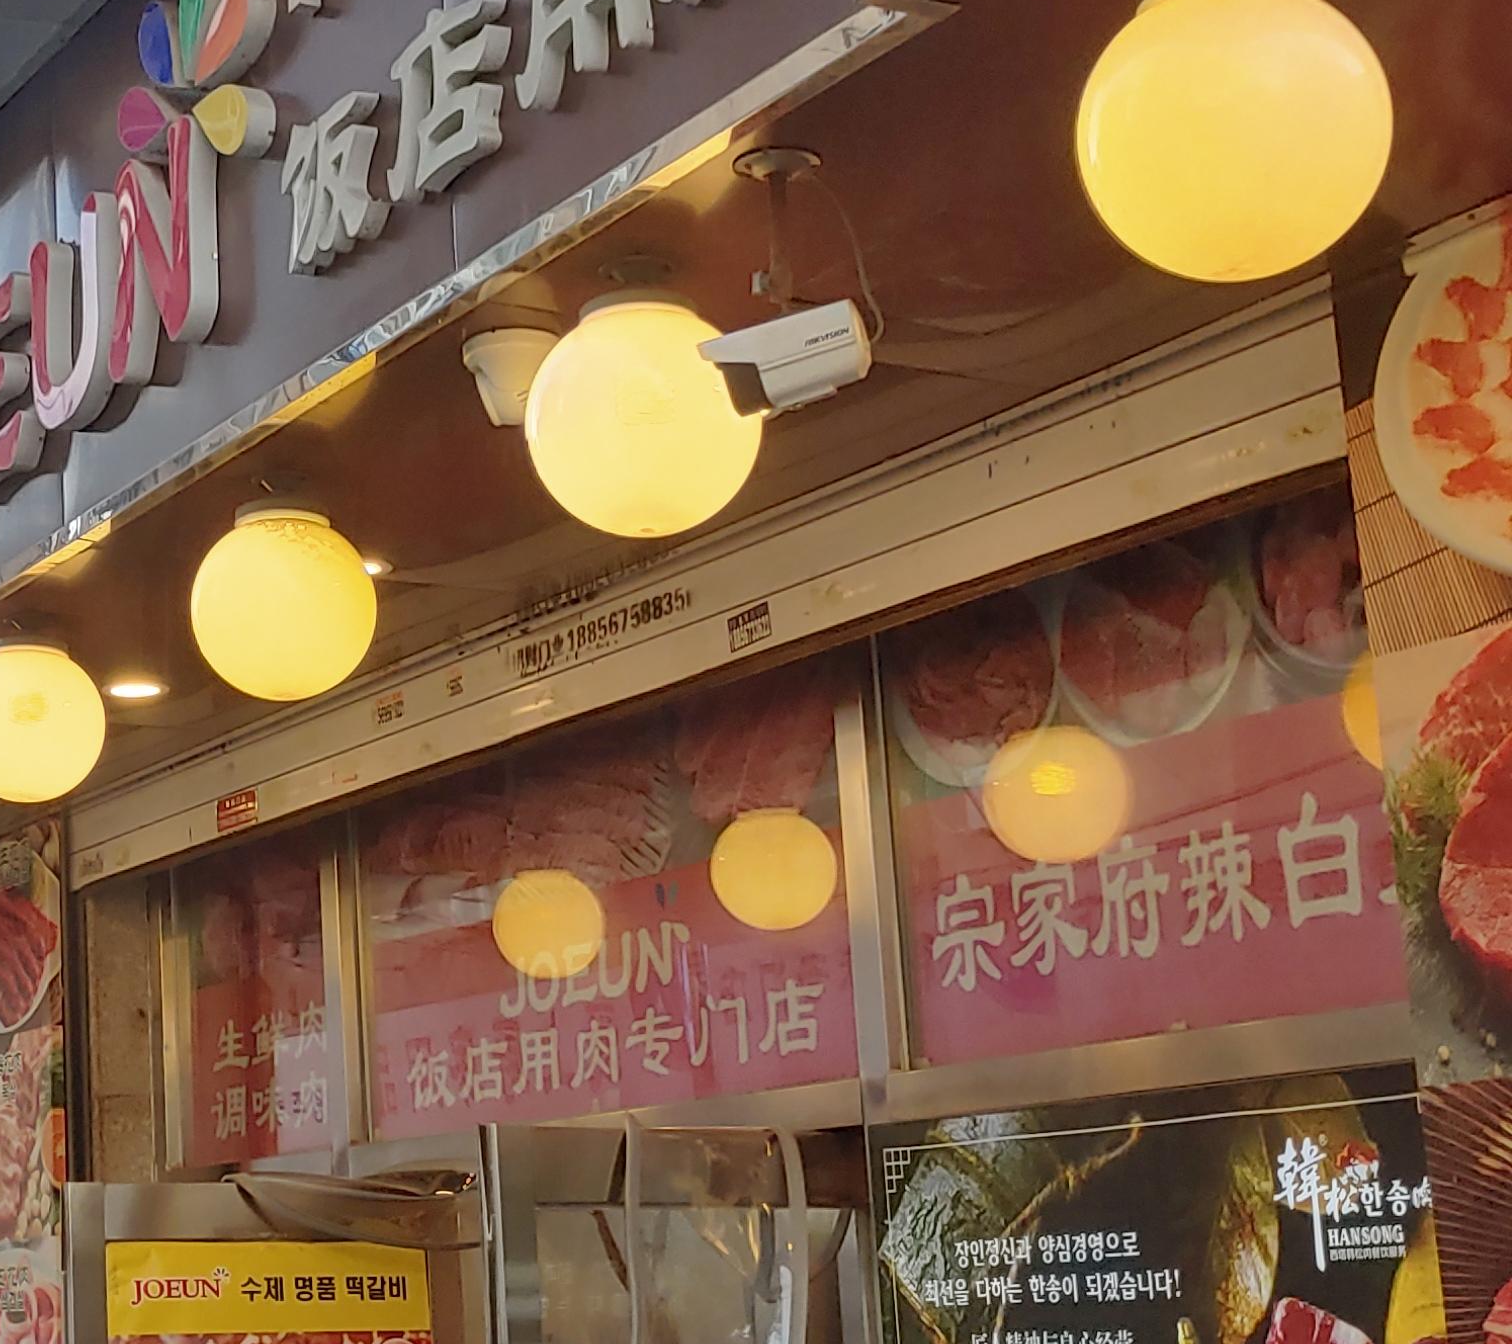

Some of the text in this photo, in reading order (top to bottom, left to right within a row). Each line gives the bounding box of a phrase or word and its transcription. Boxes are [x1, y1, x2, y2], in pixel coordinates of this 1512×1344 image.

[804, 327, 850, 347] HIKVISION
[931, 792, 1405, 992] 宗家府辣白
[499, 921, 689, 1020] JOEUN
[405, 977, 824, 1112] 饭店用肉专门店
[210, 1070, 327, 1140] 调味肉
[954, 1232, 1140, 1268] 장인정신과 양심경영으로
[1328, 1224, 1405, 1247] HANSONG
[131, 1277, 221, 1305] JOEUN
[241, 1275, 408, 1302] 수제 명품 떡갈비
[924, 1269, 1183, 1306] 최선을 다하는 한송이 되겠습니다!
